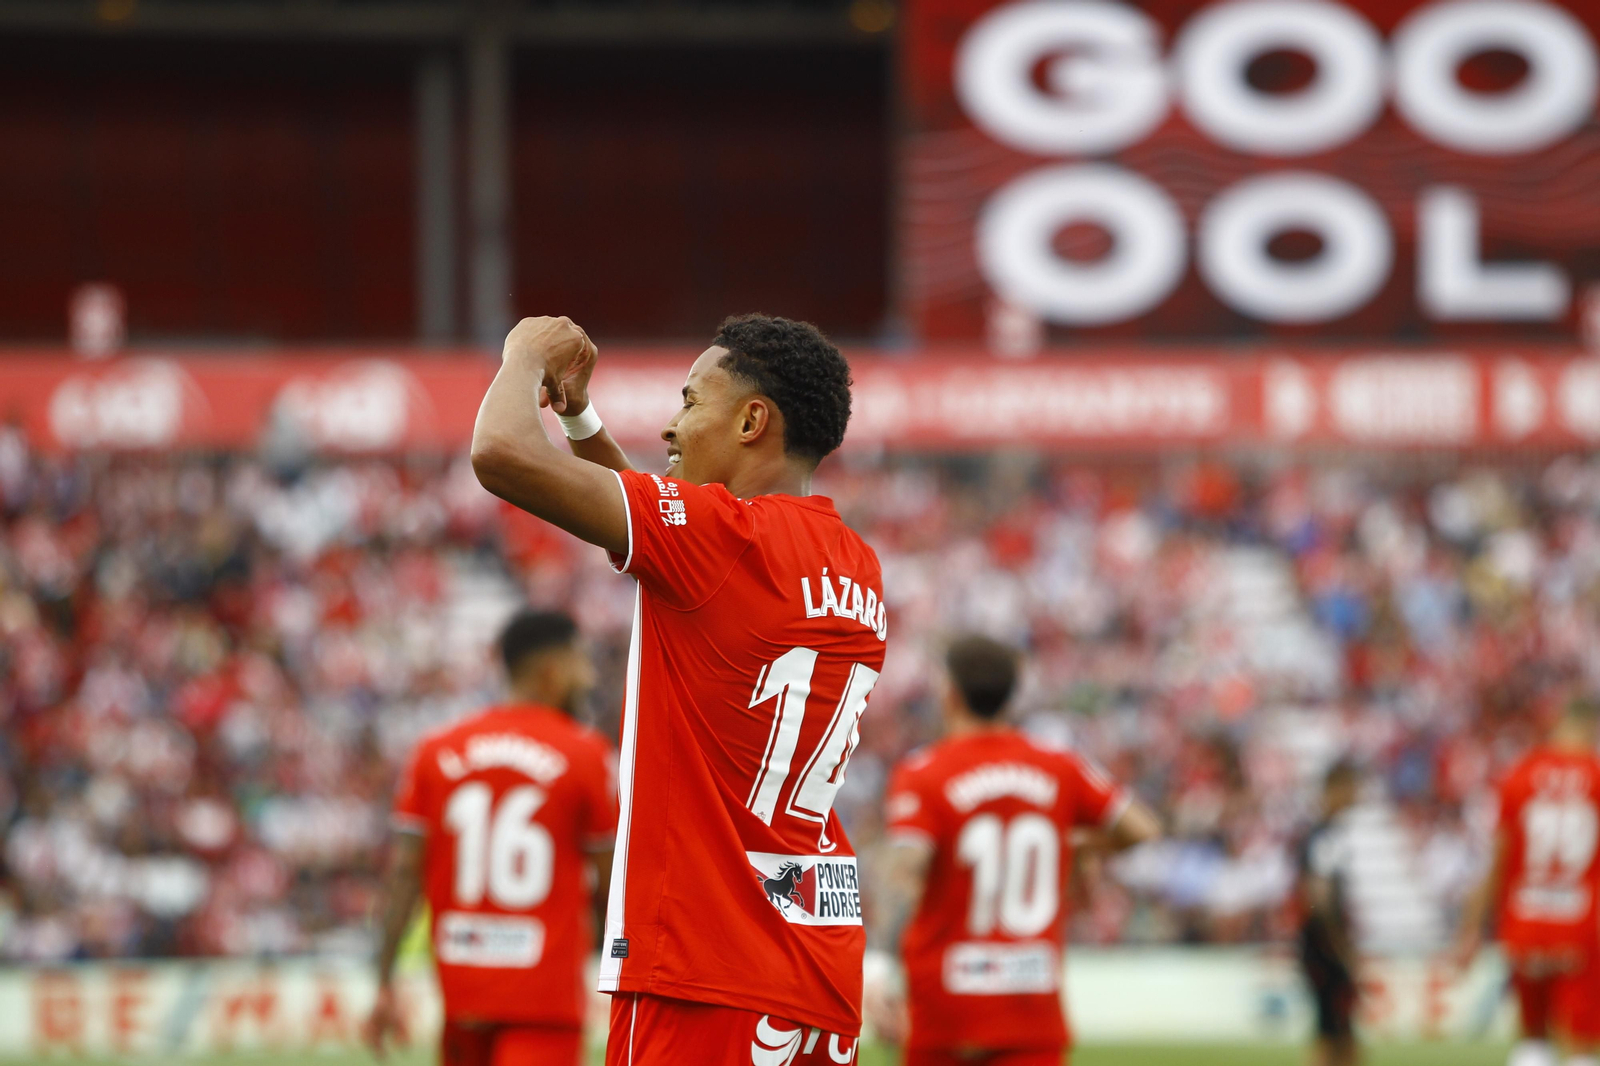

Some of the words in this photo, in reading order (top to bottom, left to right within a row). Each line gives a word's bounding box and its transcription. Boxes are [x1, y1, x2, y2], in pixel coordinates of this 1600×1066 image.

[953, 0, 1598, 156] GOO
[976, 162, 1570, 325] OOL
[801, 567, 887, 641] LÁZARO
[746, 645, 881, 854] 14
[443, 780, 556, 912] 16
[817, 862, 858, 890] POWER
[819, 891, 861, 918] HORSE
[956, 812, 1060, 938] 10
